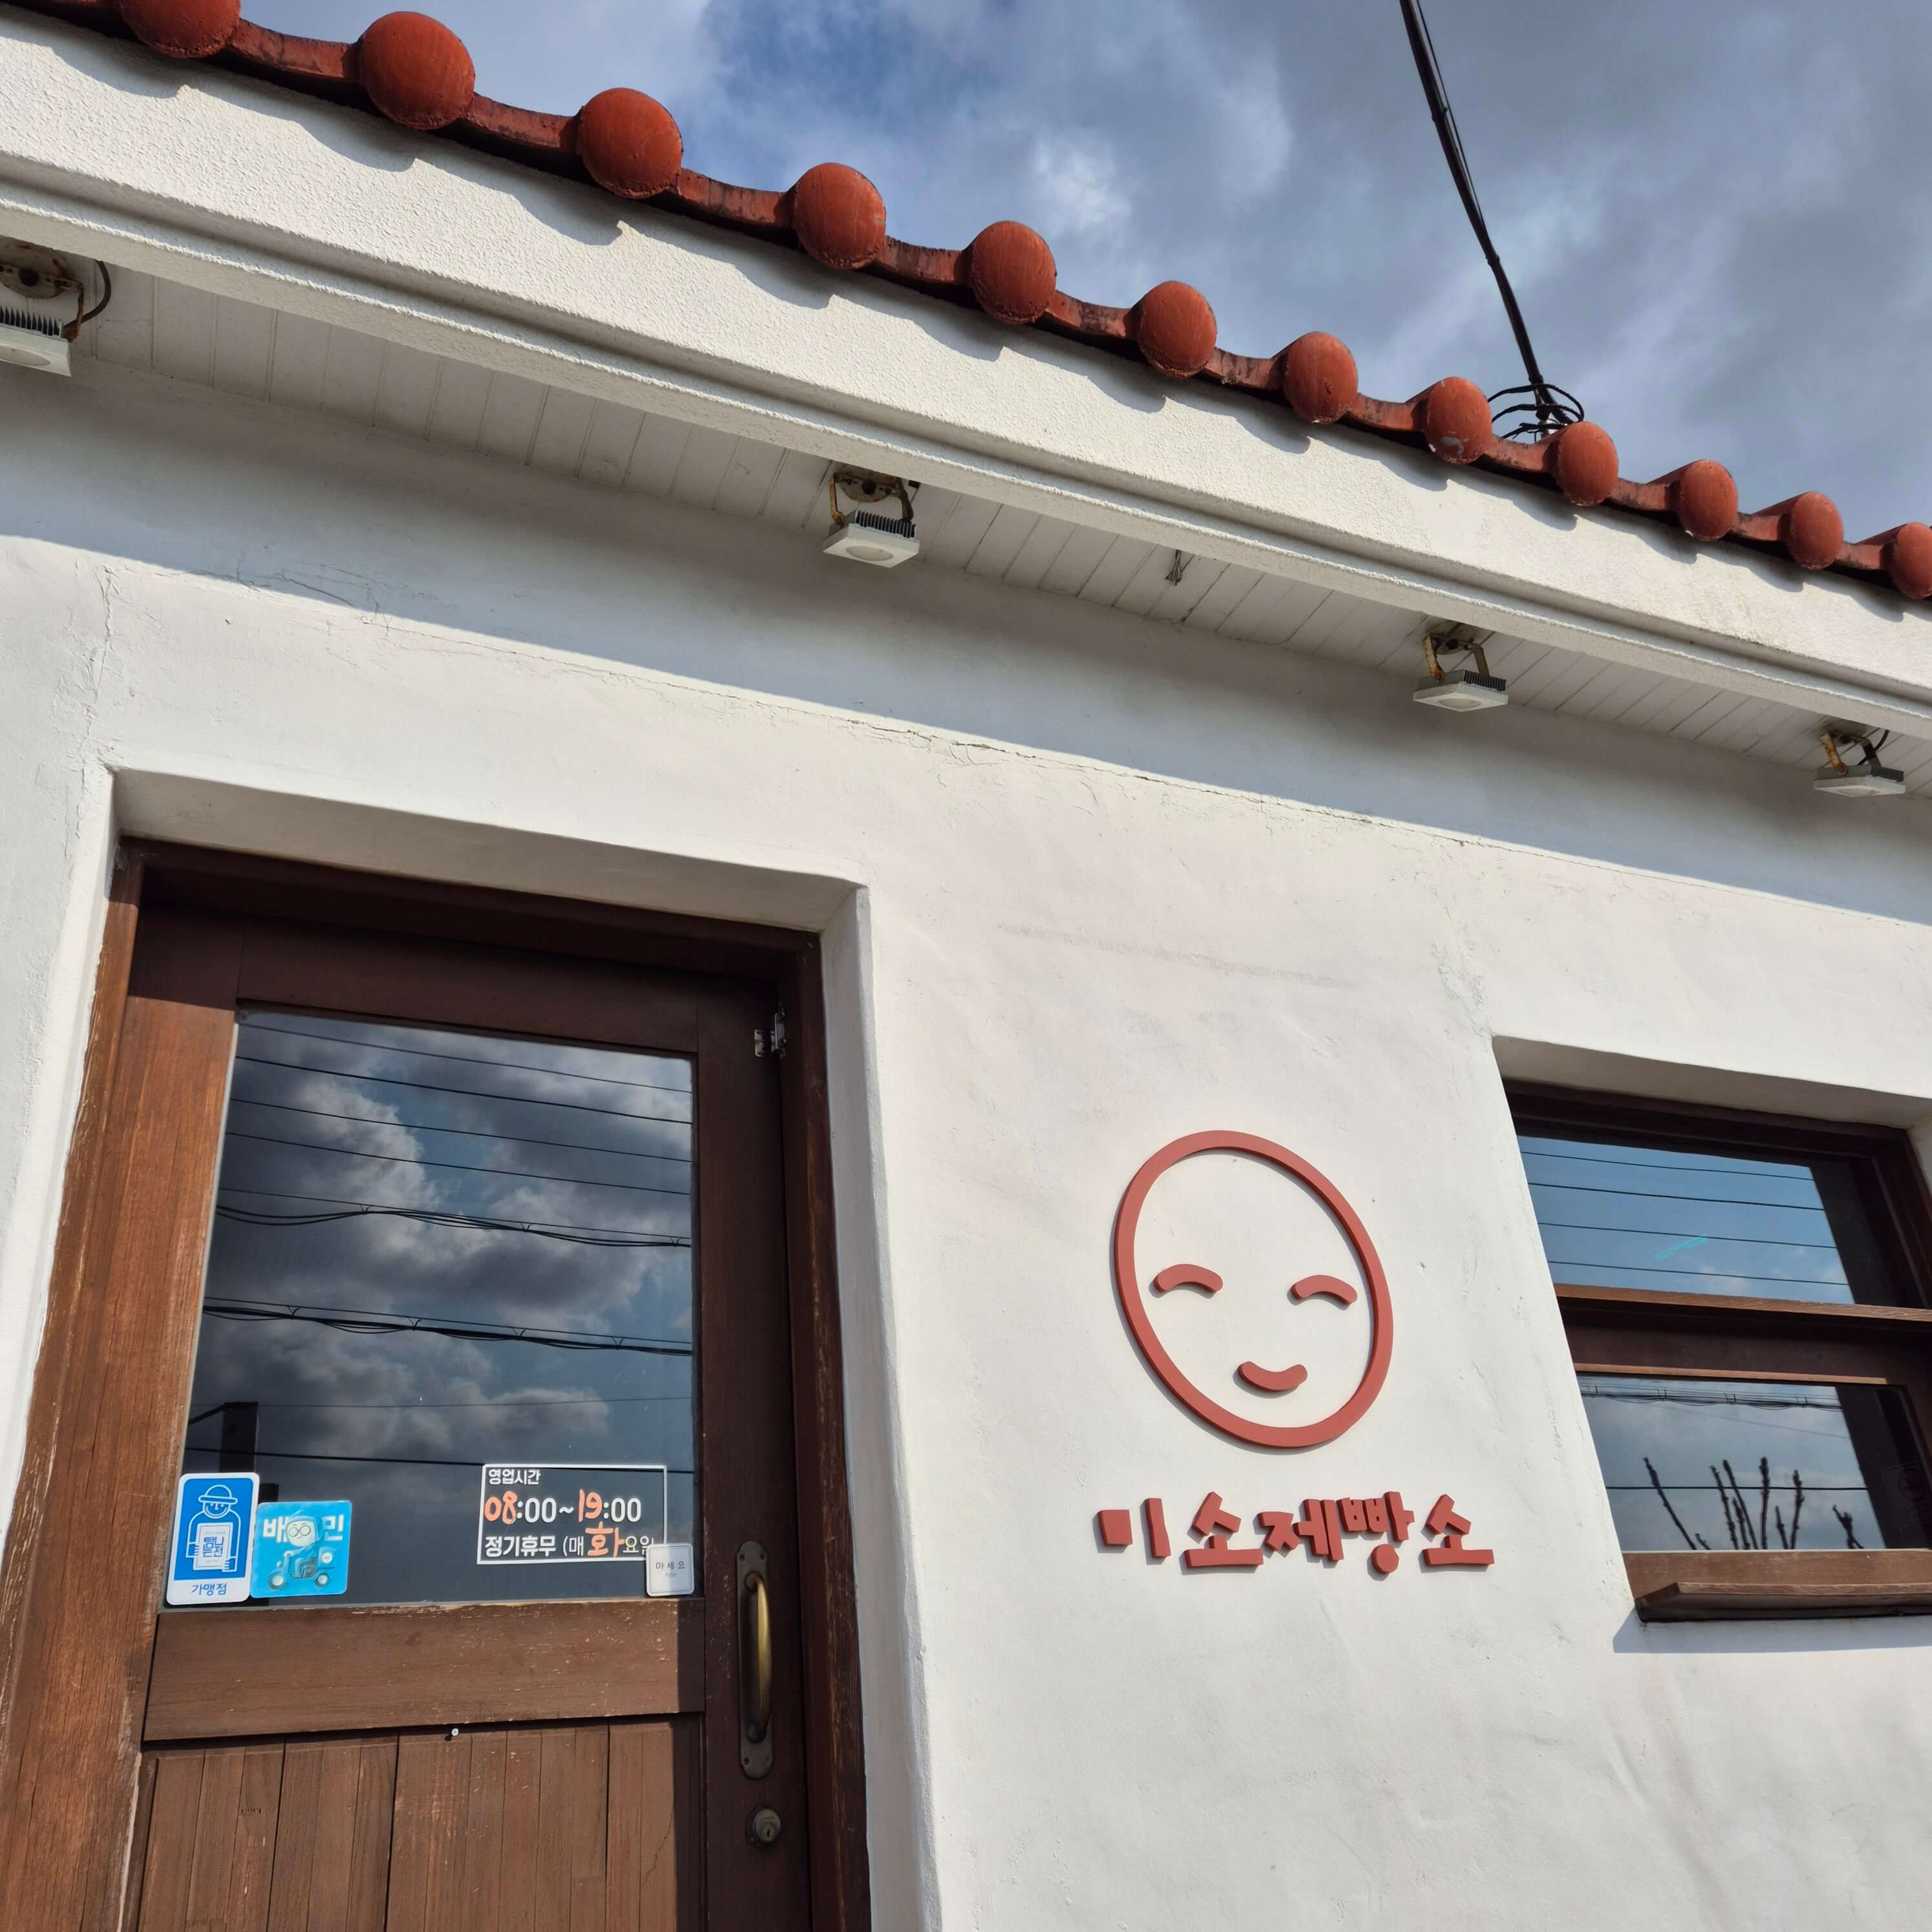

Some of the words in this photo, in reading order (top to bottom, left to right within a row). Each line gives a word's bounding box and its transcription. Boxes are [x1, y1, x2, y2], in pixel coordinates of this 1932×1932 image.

[488, 1469, 541, 1485] 영업시간
[484, 1488, 642, 1525] 08:00~19:00
[1098, 1491, 1495, 1574] 미소제빵소
[485, 1536, 557, 1557] 정기휴무
[191, 1583, 227, 1597] 가맹점
